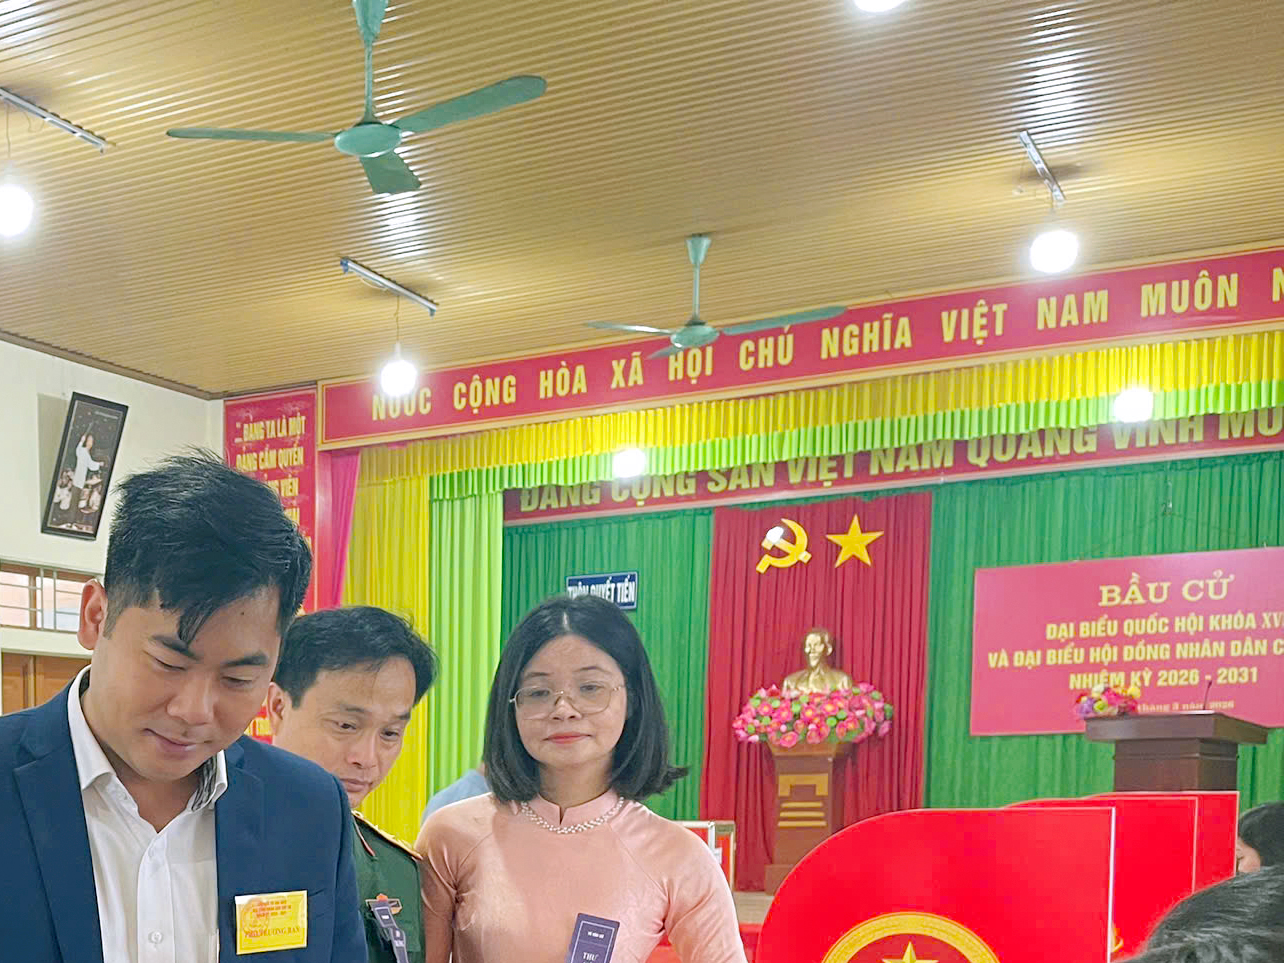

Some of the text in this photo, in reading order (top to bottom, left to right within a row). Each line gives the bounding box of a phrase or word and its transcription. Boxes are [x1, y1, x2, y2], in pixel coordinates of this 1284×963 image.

[453, 374, 517, 415] CỘNG
[539, 361, 588, 399] HÒA
[611, 351, 644, 389] XÃ
[820, 313, 912, 360] NGHĨA
[940, 299, 1008, 346] VIỆT
[1037, 290, 1109, 331] NAM
[1140, 269, 1239, 318] MUÔN
[1098, 569, 1235, 606] BẦU CỬ
[1046, 622, 1075, 642] ĐẠI
[1079, 614, 1118, 638] BIỂU
[1123, 612, 1169, 637] QUỐC
[1174, 612, 1204, 636] HỘI
[1209, 609, 1256, 632] KHÓA
[988, 648, 1009, 668] VÀ
[1013, 650, 1041, 670] ĐẠI
[1046, 642, 1084, 665] BIỂU
[1089, 643, 1118, 666] HỘI
[1176, 638, 1225, 660] NHÂN
[1230, 636, 1267, 657] DÂN
[1217, 667, 1258, 685] 2031
